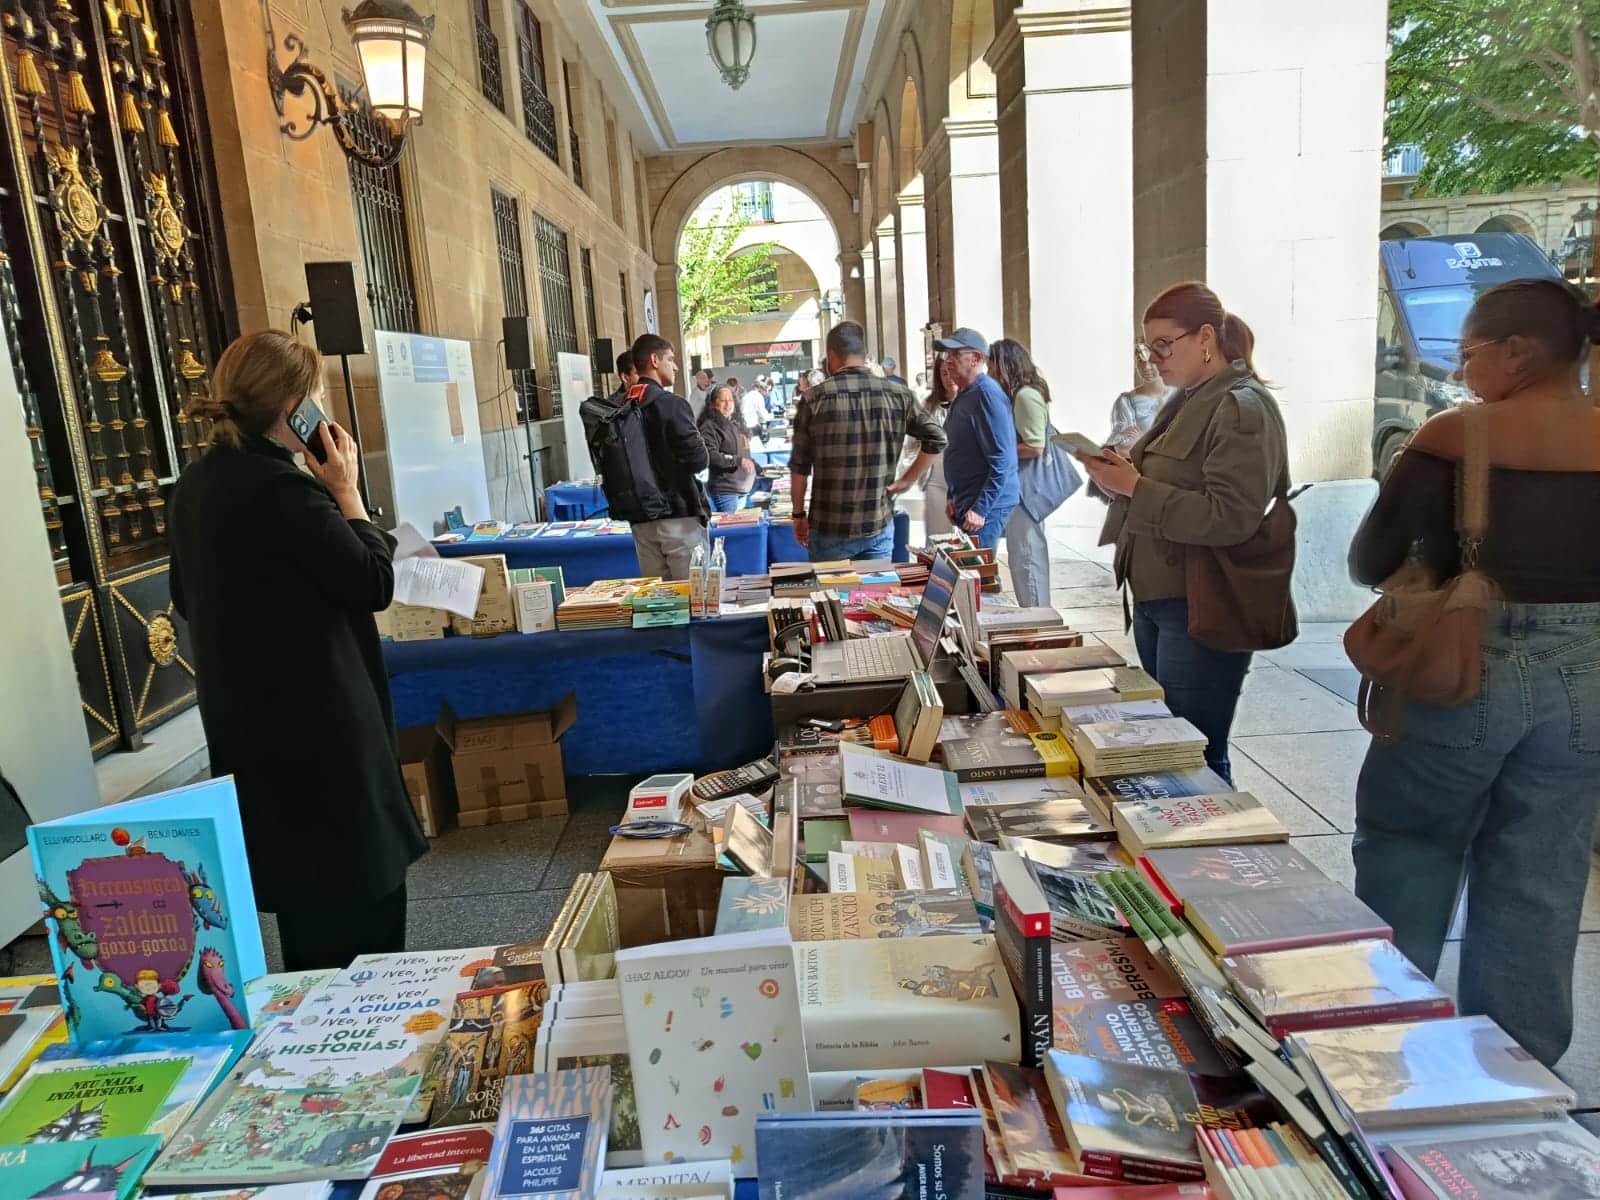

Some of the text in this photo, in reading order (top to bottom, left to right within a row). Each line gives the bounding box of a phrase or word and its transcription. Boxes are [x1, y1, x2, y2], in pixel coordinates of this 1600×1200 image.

[969, 768, 997, 778] SANTO
[807, 948, 823, 1007] JOHN BARTON
[1050, 951, 1085, 1000] BIBLIA
[358, 998, 441, 1014] CIUDAD
[1133, 1003, 1160, 1031] PASO
[323, 1026, 381, 1042] ¡QUÉ
[1106, 1013, 1137, 1055] NUEVO
[1152, 1033, 1167, 1043] A
[278, 1039, 407, 1056] HISTORIAS!
[529, 1123, 571, 1134] 365 CITAS
[516, 1132, 581, 1144] PARA AVANZAR
[522, 1143, 570, 1154] EN LA VIDA
[393, 1147, 484, 1165] La libertad interior
[521, 1152, 568, 1165] ESPIRITUAL
[933, 1144, 945, 1177] Somos
[522, 1166, 562, 1178] JACQUES
[522, 1177, 559, 1188] PHILIPPE
[934, 1179, 943, 1191] su
